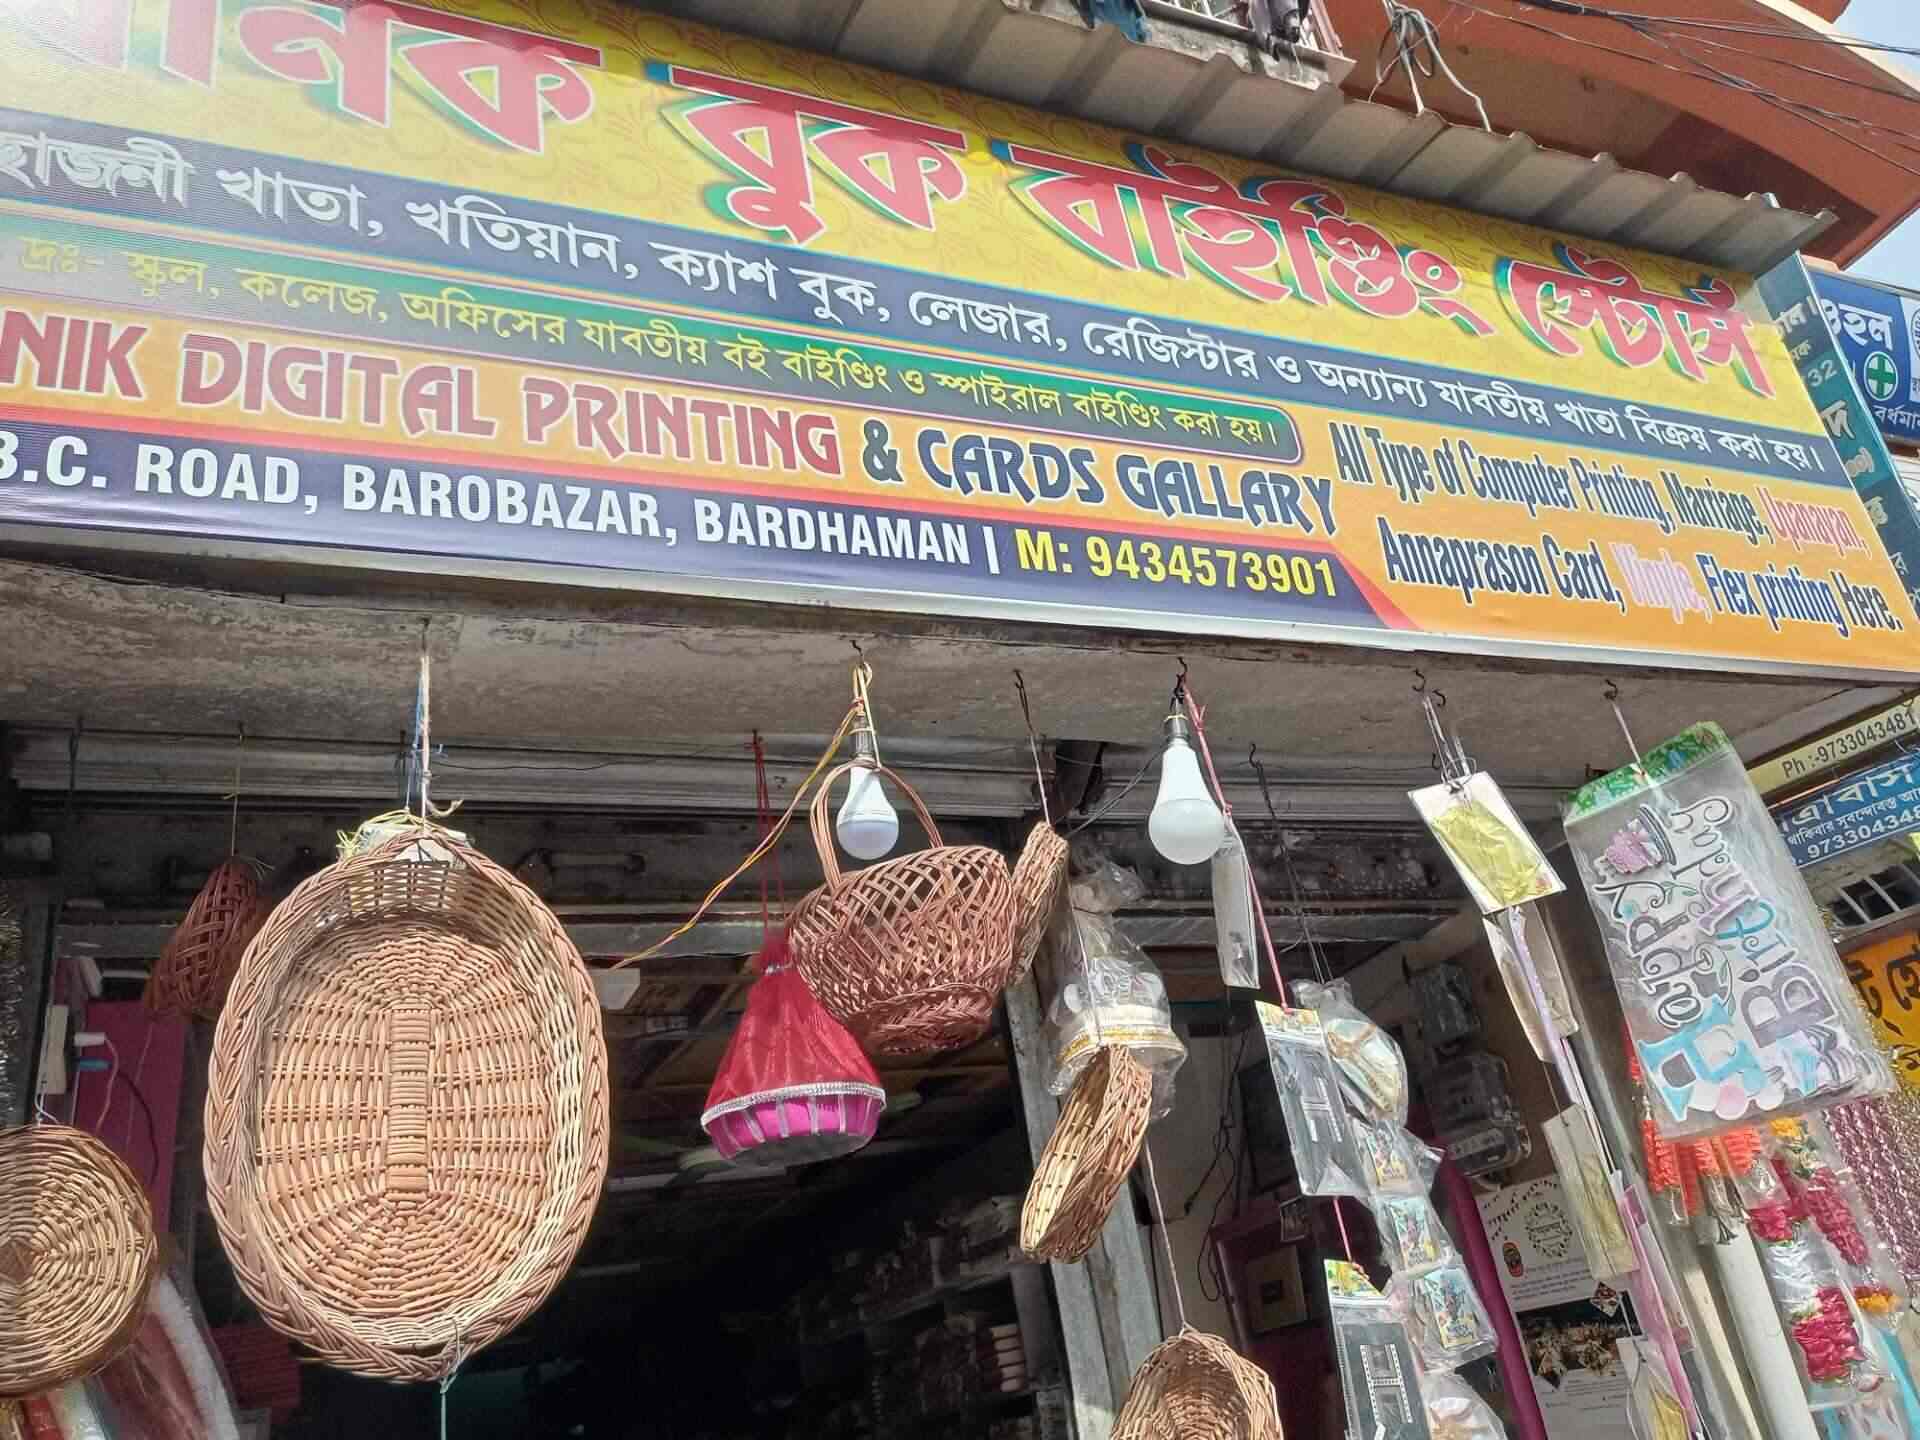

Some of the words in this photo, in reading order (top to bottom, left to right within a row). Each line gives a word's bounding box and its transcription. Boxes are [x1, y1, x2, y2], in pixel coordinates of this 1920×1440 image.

[660, 62, 969, 246] বুক
[216, 167, 383, 237] খাতা,
[405, 195, 638, 279] খতিয়ান,
[648, 242, 779, 300] ক্যাশ
[789, 267, 890, 326] বুক,
[909, 291, 1067, 352] লেজার,
[1083, 317, 1259, 380] রেজিস্টার
[1267, 355, 1301, 383] ও
[1306, 359, 1426, 407] অন্যান্য
[1431, 380, 1550, 426] যাবতীয়
[1554, 400, 1626, 438] খাতা
[1624, 404, 1711, 453] বিক্রয়
[1709, 430, 1769, 463] করা
[234, 268, 388, 322] কলেজ,
[399, 287, 567, 345] অফিসের
[576, 319, 708, 366] যাবতীয়
[716, 333, 773, 380] বই
[899, 370, 925, 395] ও
[930, 370, 1063, 417] স্পাইরাল
[1167, 407, 1221, 438] করা
[0, 308, 148, 400] NIK
[180, 332, 498, 439] DIGITAL
[521, 375, 844, 479] PRINTING
[861, 417, 904, 484] &
[915, 427, 1106, 505] CARDS
[1115, 453, 1338, 536] GALLARY
[0, 430, 107, 488] B.C.
[134, 443, 318, 515] ROAD,
[343, 464, 677, 546] BAROBAZAR,
[694, 498, 971, 564] BARDHAMAN
[1014, 529, 1073, 574] M:
[1085, 535, 1337, 597] 9434573901
[1328, 421, 1374, 485] All
[1363, 426, 1436, 504] Type
[1432, 437, 1466, 497] of
[1458, 439, 1579, 518] Computer
[1568, 456, 1676, 536] Printing,
[1658, 469, 1775, 549] Marriage,
[1376, 515, 1552, 605] Annaprason
[1541, 533, 1627, 617] Card,
[1696, 552, 1761, 617] Flex
[1752, 562, 1850, 639] printing
[1829, 569, 1905, 632] Here.
[1594, 878, 1758, 1121] Happy
[1669, 796, 1840, 1050] Birthday
